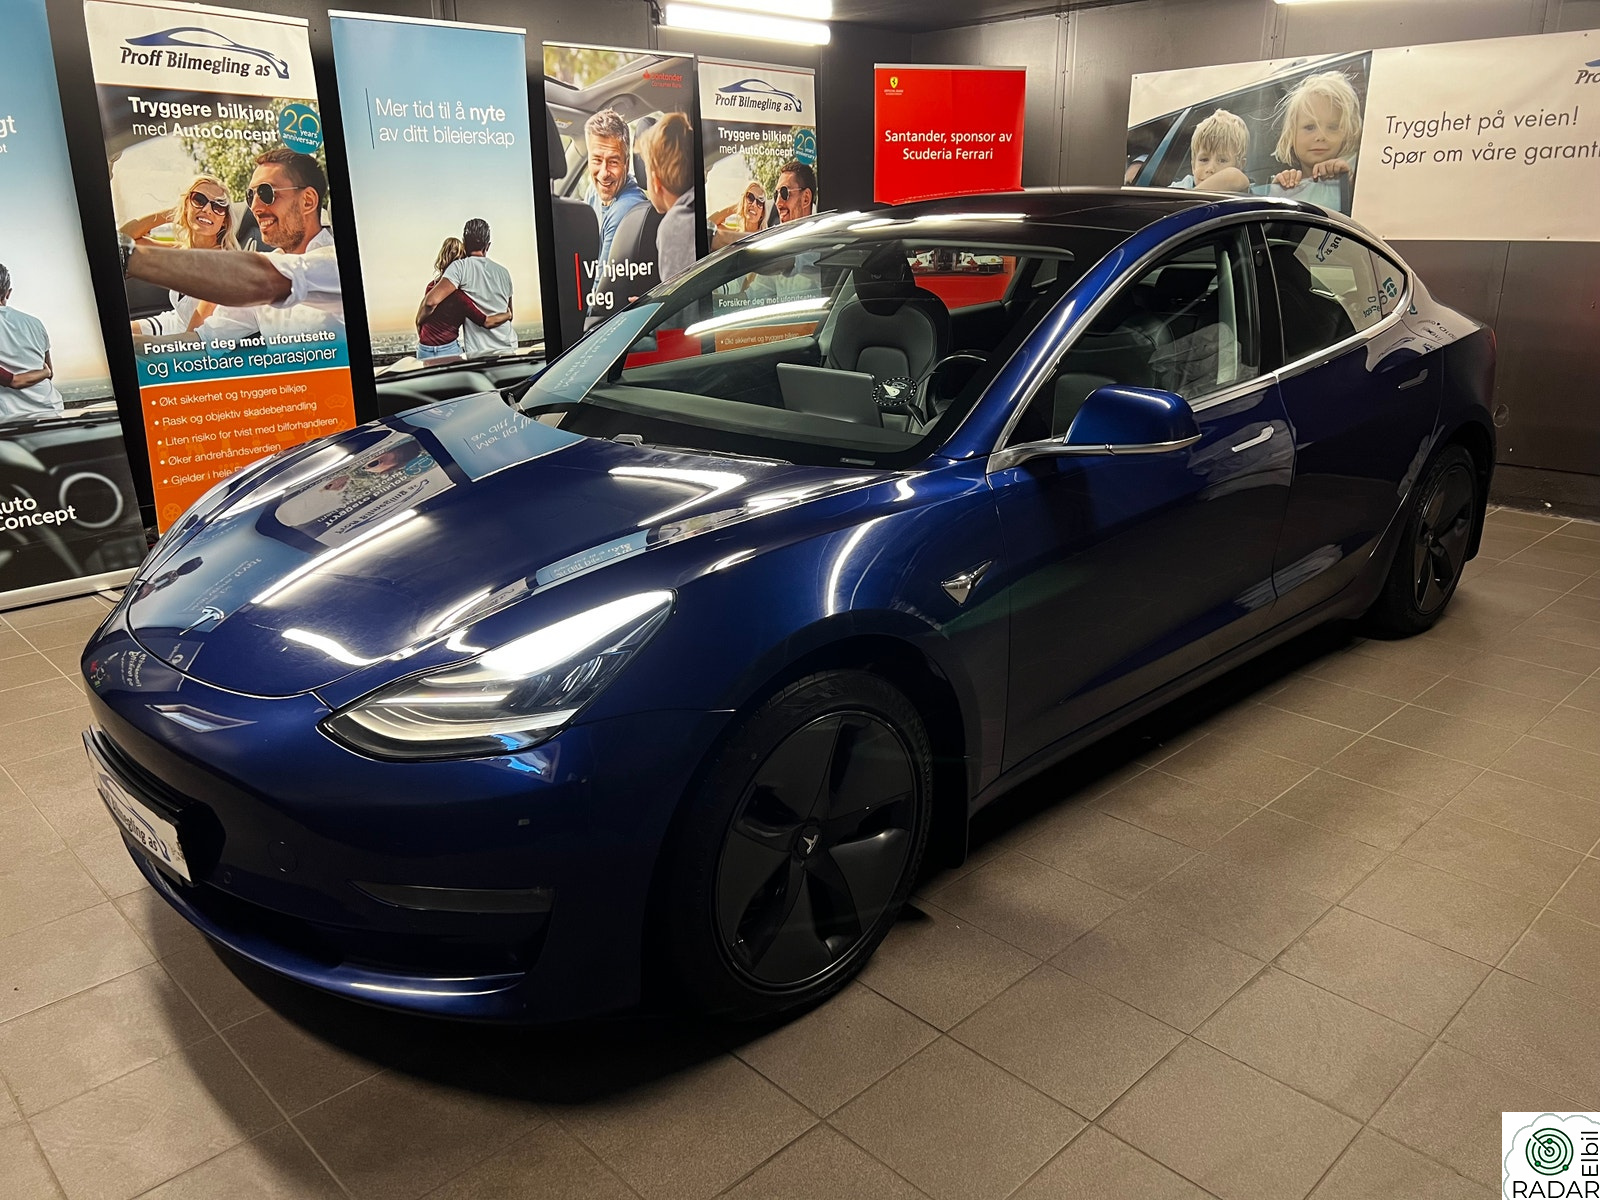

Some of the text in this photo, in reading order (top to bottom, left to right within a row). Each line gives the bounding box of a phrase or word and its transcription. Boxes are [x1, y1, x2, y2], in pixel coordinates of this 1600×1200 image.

[120, 46, 271, 77] Proff Bilmegling as
[128, 96, 276, 123] Tryggere bilkjøp
[375, 97, 507, 126] Mer tid til å nyte
[715, 93, 793, 112] Proff Bilmegling as
[284, 109, 320, 133] 20
[1386, 105, 1579, 139] Trygghet på veien!
[132, 122, 279, 144] med AutoConcept
[282, 132, 321, 148] anniversary
[300, 130, 318, 139] years
[379, 126, 515, 148] av ditt bileierskap
[718, 127, 793, 144] Tryggere bilkjøp
[885, 130, 1013, 145] Santander, sponsor av
[720, 144, 793, 159] med AutoConcept
[903, 148, 993, 160] Scuderia Ferrari
[1381, 146, 1426, 170] Spør
[1433, 149, 1463, 162] om
[1471, 141, 1517, 162] våre
[583, 260, 654, 283] Vi hjelper
[585, 290, 614, 310] deg
[718, 298, 751, 308] Forsikrer
[752, 297, 765, 306] deg
[766, 296, 779, 304] mot
[143, 330, 336, 355] Forsikrer deg mot uforutsette
[147, 347, 338, 378] og kostbare reparasjoner
[159, 383, 308, 407] Økt sikkerhet og tryggere bilkjøp
[162, 401, 317, 427] Rask og objektiv skadebehandling
[165, 416, 338, 447] Liten risiko for tvist med bilforhandleren
[168, 443, 281, 466] Øker andrehåndsverdien
[171, 472, 205, 486] Gjelder
[207, 470, 211, 479] i
[212, 467, 233, 479] hele
[0, 496, 37, 515] uto
